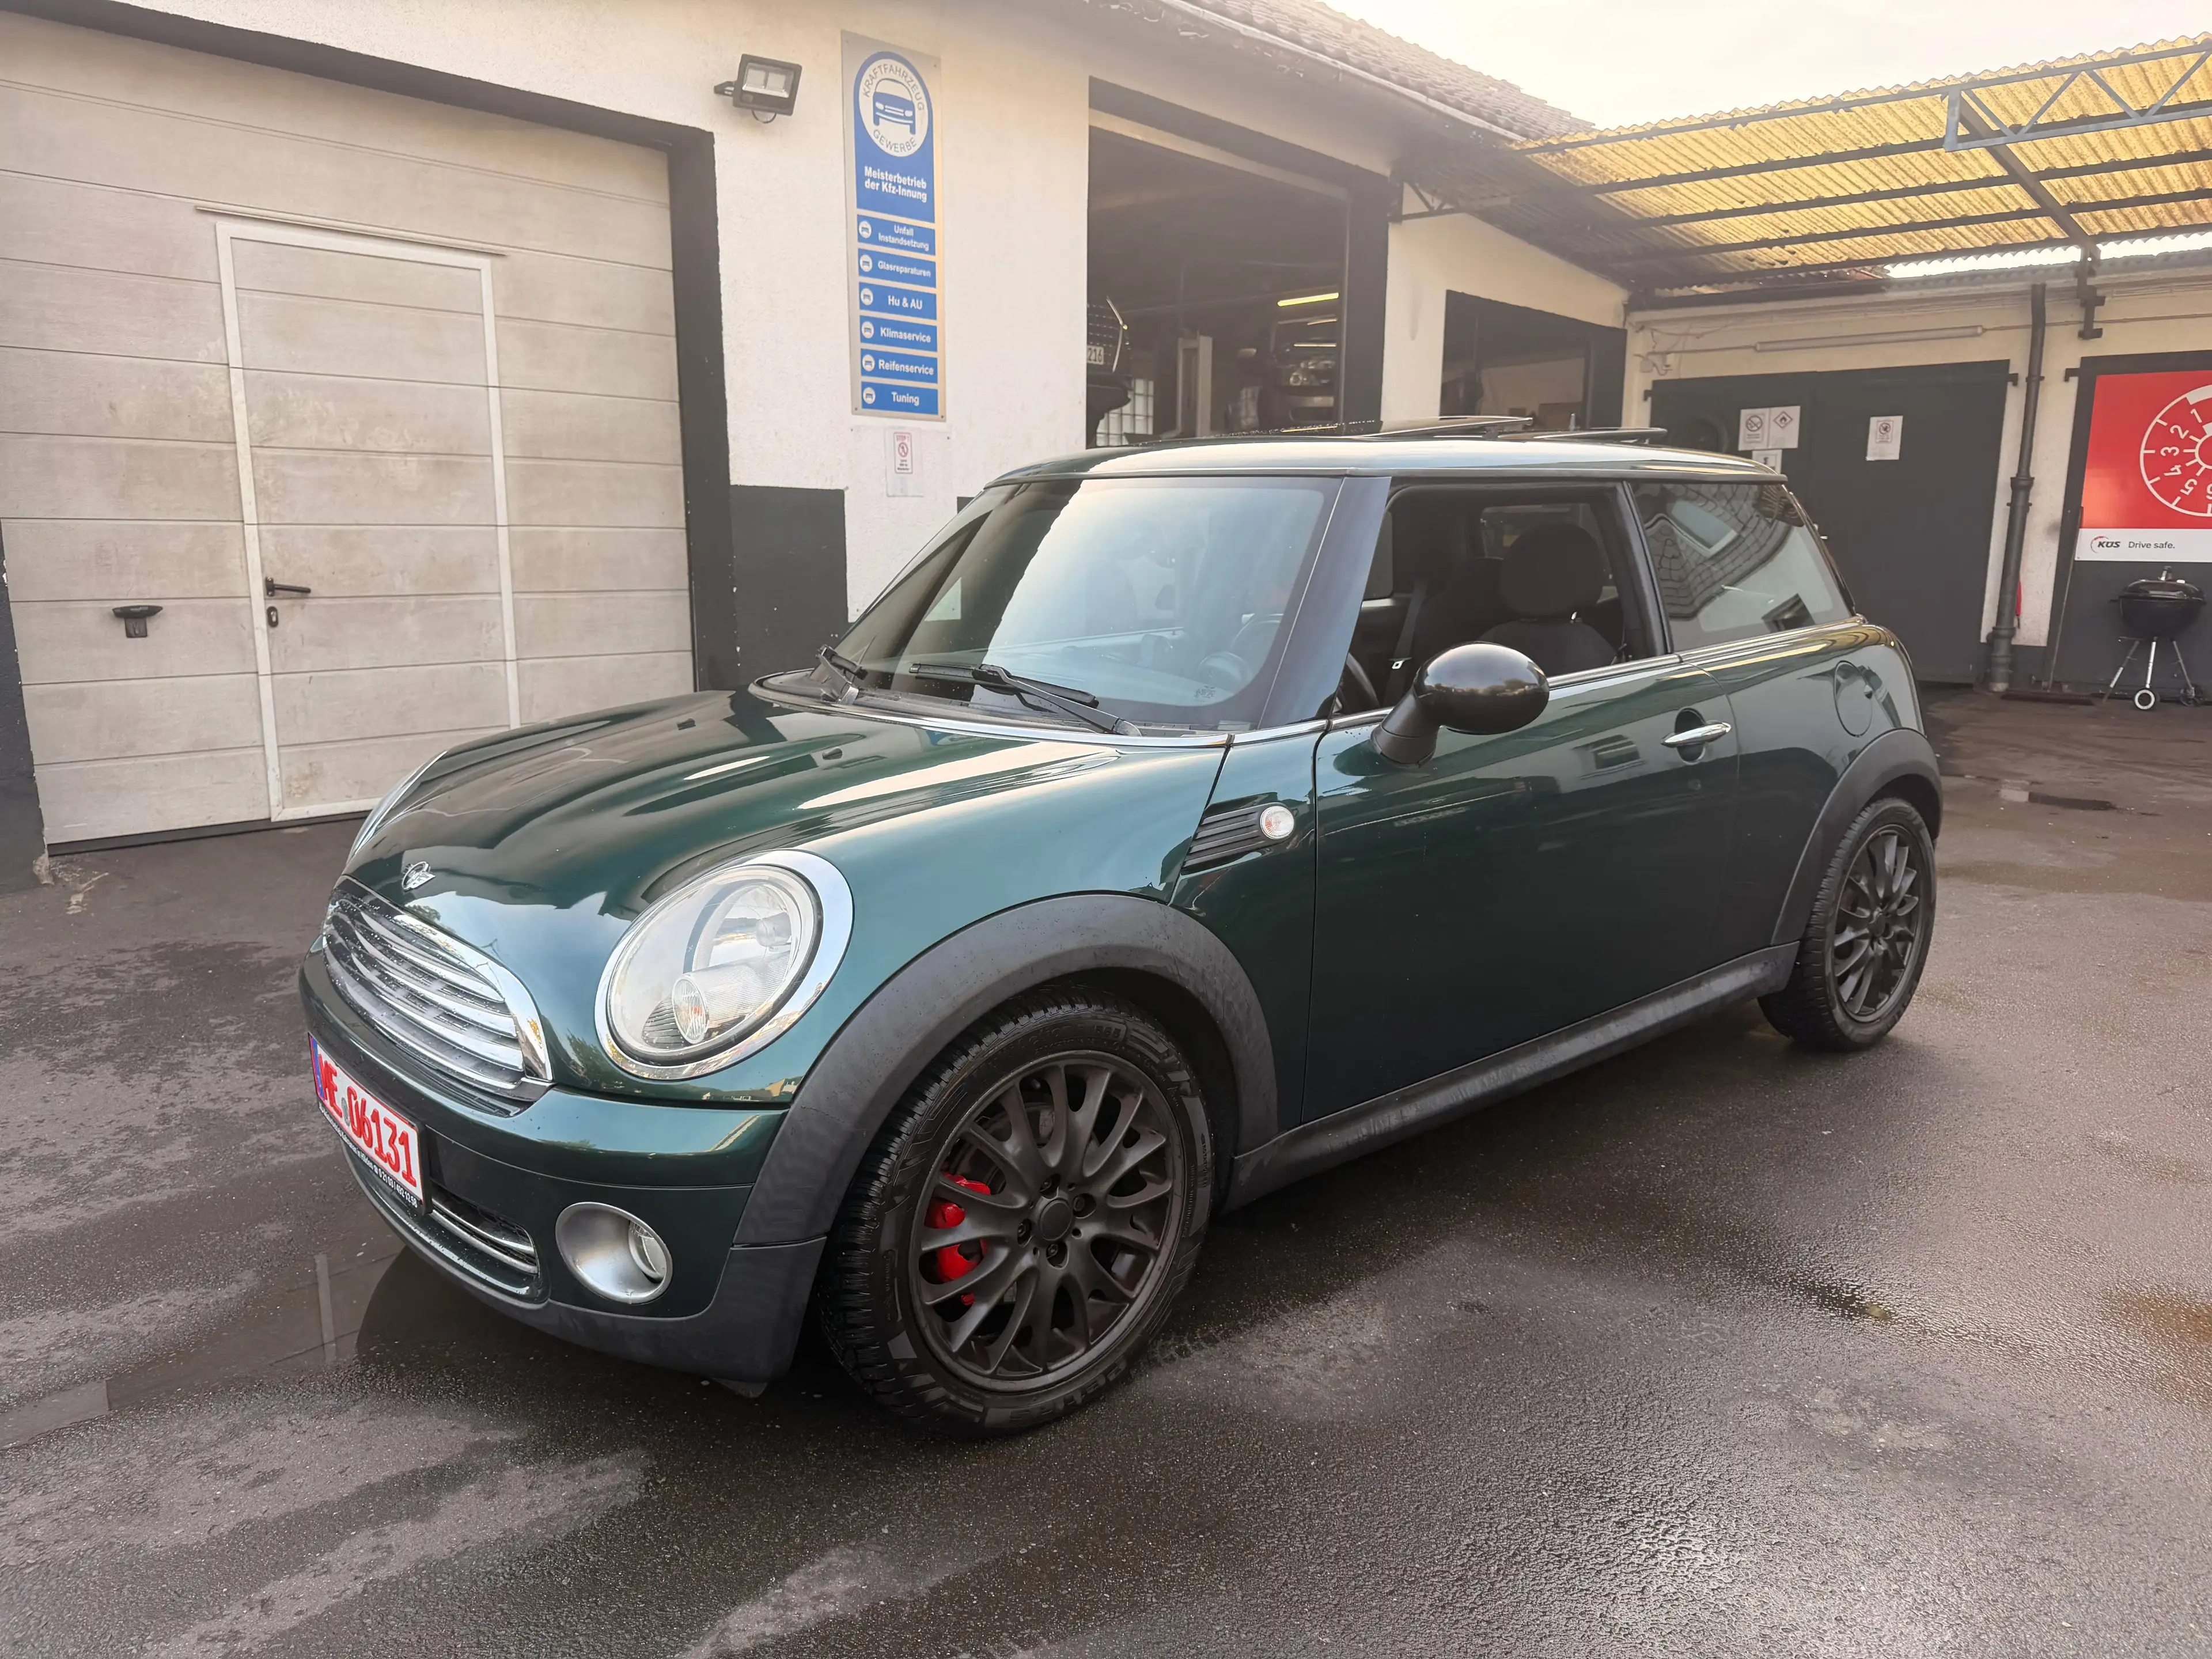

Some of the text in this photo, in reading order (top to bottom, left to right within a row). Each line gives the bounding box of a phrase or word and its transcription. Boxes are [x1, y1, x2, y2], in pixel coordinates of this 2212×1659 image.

[862, 63, 925, 111] KRAFTFAHRZEUG
[873, 129, 917, 153] GEWERBE
[865, 166, 927, 189] Meisterbetrieb
[865, 179, 927, 203] der Kfz-Innung
[894, 225, 914, 236] Unfall
[878, 232, 929, 251] Instandsetzung
[878, 260, 931, 277] Glasreparaturen
[888, 295, 923, 310] Hu & AU
[880, 327, 931, 343] Klimaservice
[878, 359, 934, 376] Reifenservice
[891, 392, 920, 407] Tuning
[2169, 425, 2189, 440] 2
[2160, 446, 2180, 456] 3
[2164, 464, 2181, 476] 4
[2180, 479, 2198, 495] 5
[2154, 541, 2175, 549] safe.
[347, 1086, 416, 1187] 06131
